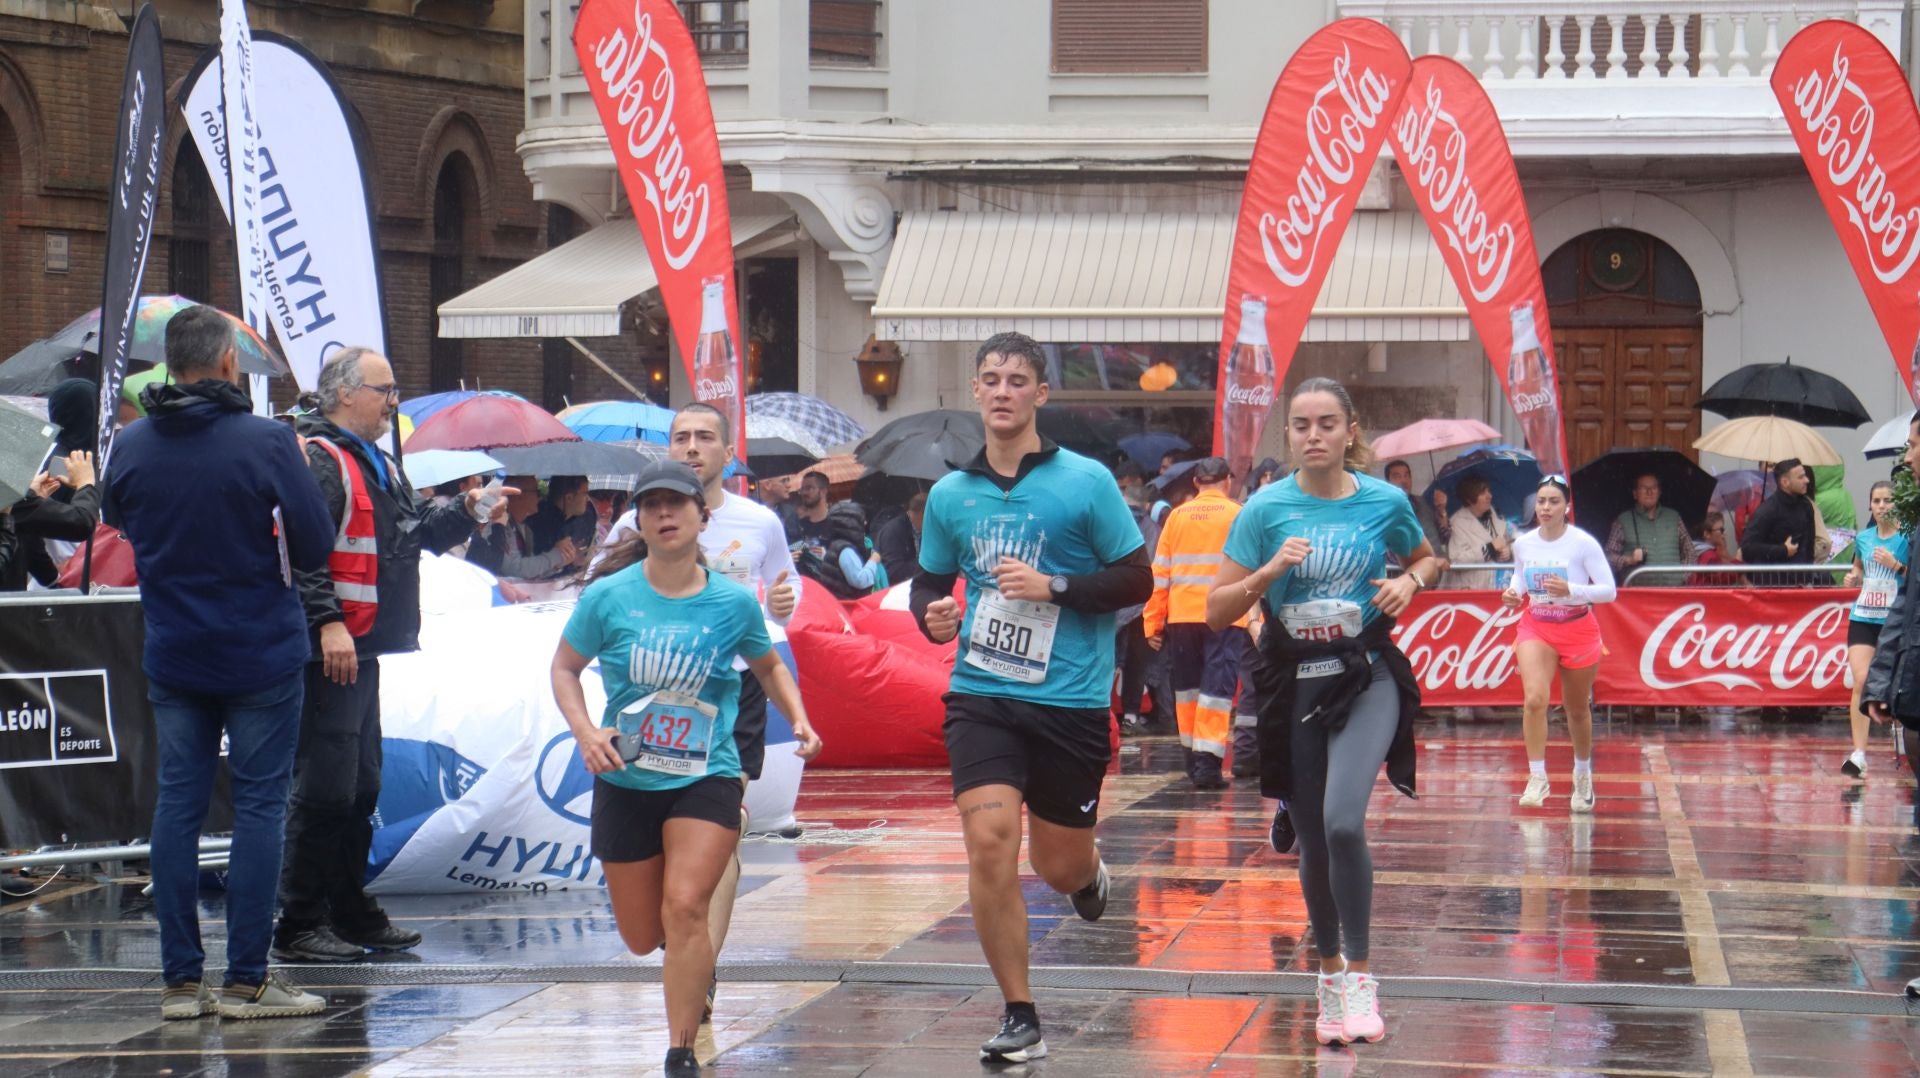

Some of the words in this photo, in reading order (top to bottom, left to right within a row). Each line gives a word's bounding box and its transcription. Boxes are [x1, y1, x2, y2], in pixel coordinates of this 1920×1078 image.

[1259, 41, 1392, 288] Coca-Cola
[1609, 252, 1621, 270] 9
[1190, 513, 1209, 521] CIVIL
[986, 617, 1032, 657] 930
[992, 661, 1031, 677] HYUNDAI
[0, 702, 47, 731] LEÓN
[60, 726, 72, 737] ES
[640, 713, 692, 749] 432
[60, 739, 101, 752] DEPORTE
[648, 755, 692, 769] HYUNDAI
